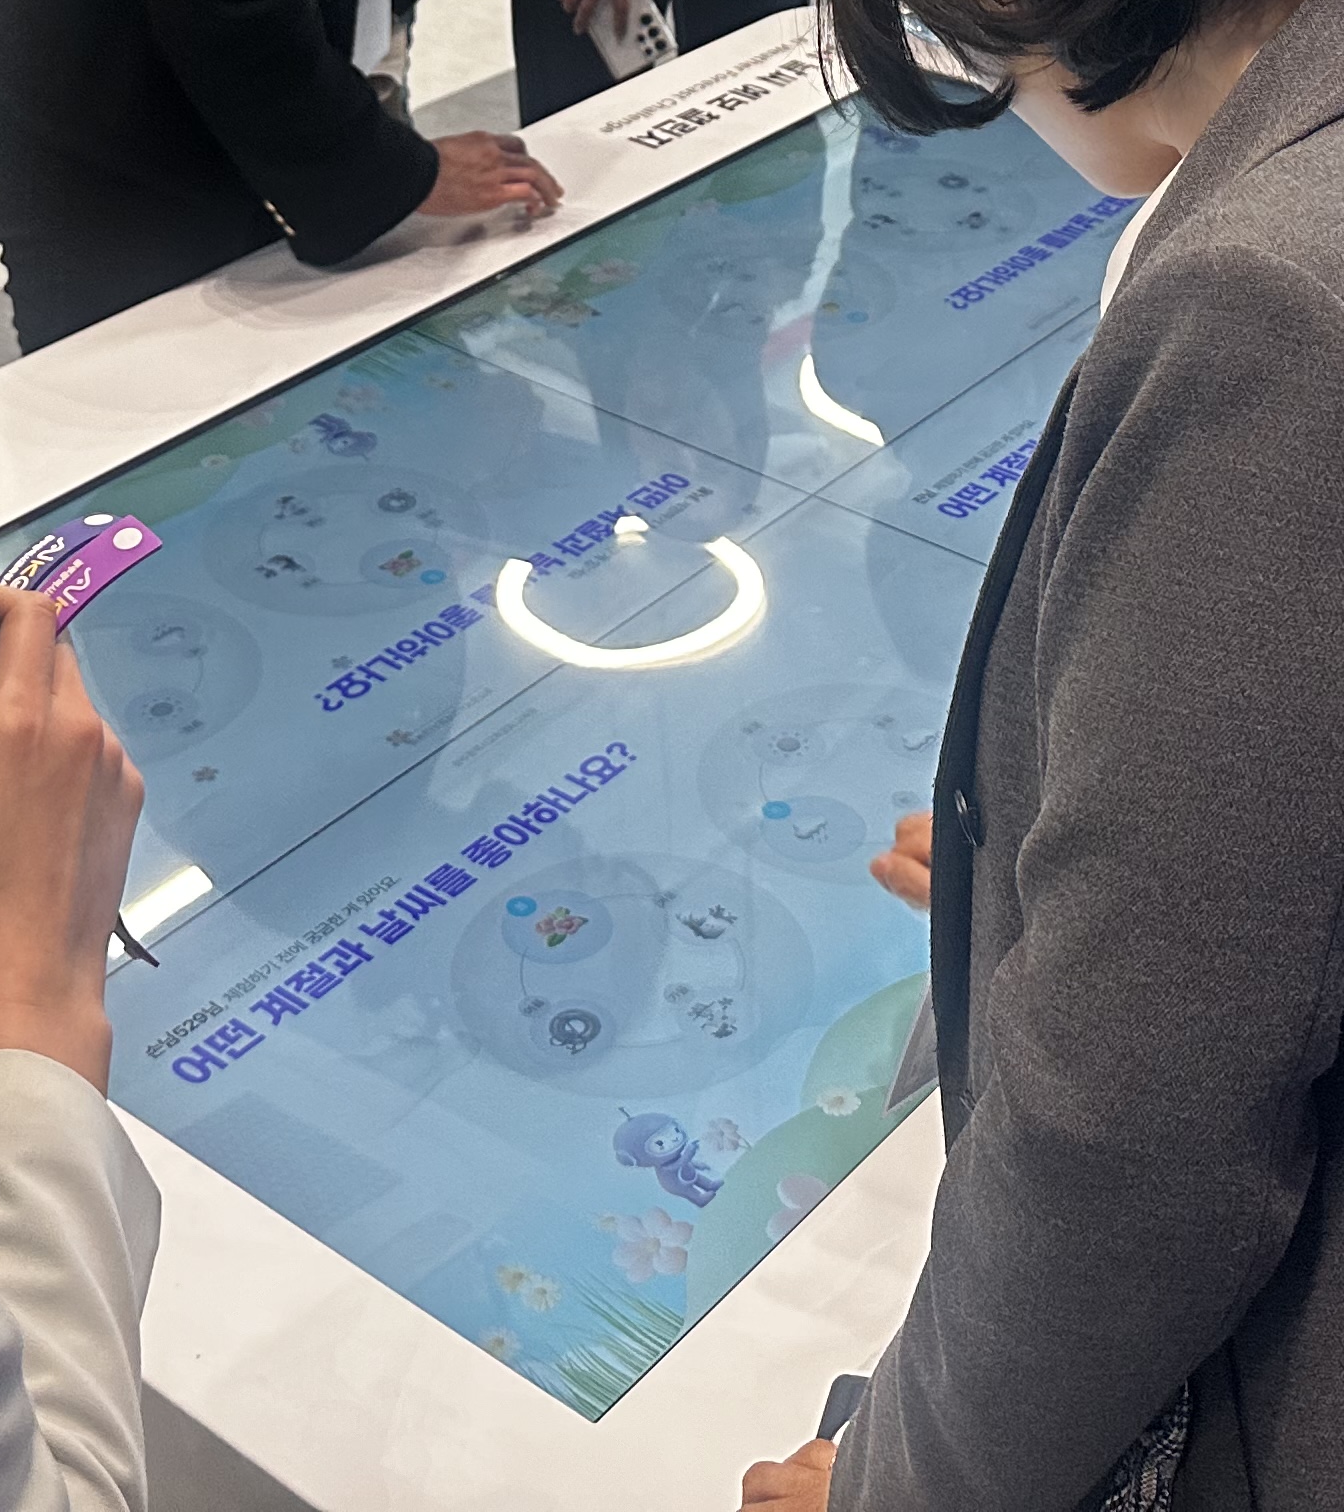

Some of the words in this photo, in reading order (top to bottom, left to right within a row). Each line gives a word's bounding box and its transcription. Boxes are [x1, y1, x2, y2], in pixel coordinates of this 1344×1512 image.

[677, 70, 738, 101] Forecast
[705, 82, 771, 111] 예보
[599, 98, 677, 134] Challenge
[627, 107, 721, 150] 챌린지
[944, 245, 1054, 310] 좋아하나요?
[626, 472, 691, 510] 어떤
[937, 481, 1000, 518] 어떤
[315, 603, 485, 714] 좋아하나요?
[171, 1017, 266, 1084] 어떤
[249, 938, 375, 1026] 계절과
[358, 863, 479, 945] 날씨를
[461, 741, 637, 869] 좋아하나요?
[145, 1000, 229, 1059] 손님529님,
[223, 960, 281, 1004] 체험하기
[275, 939, 308, 964] 전에
[302, 912, 345, 945] 궁금한
